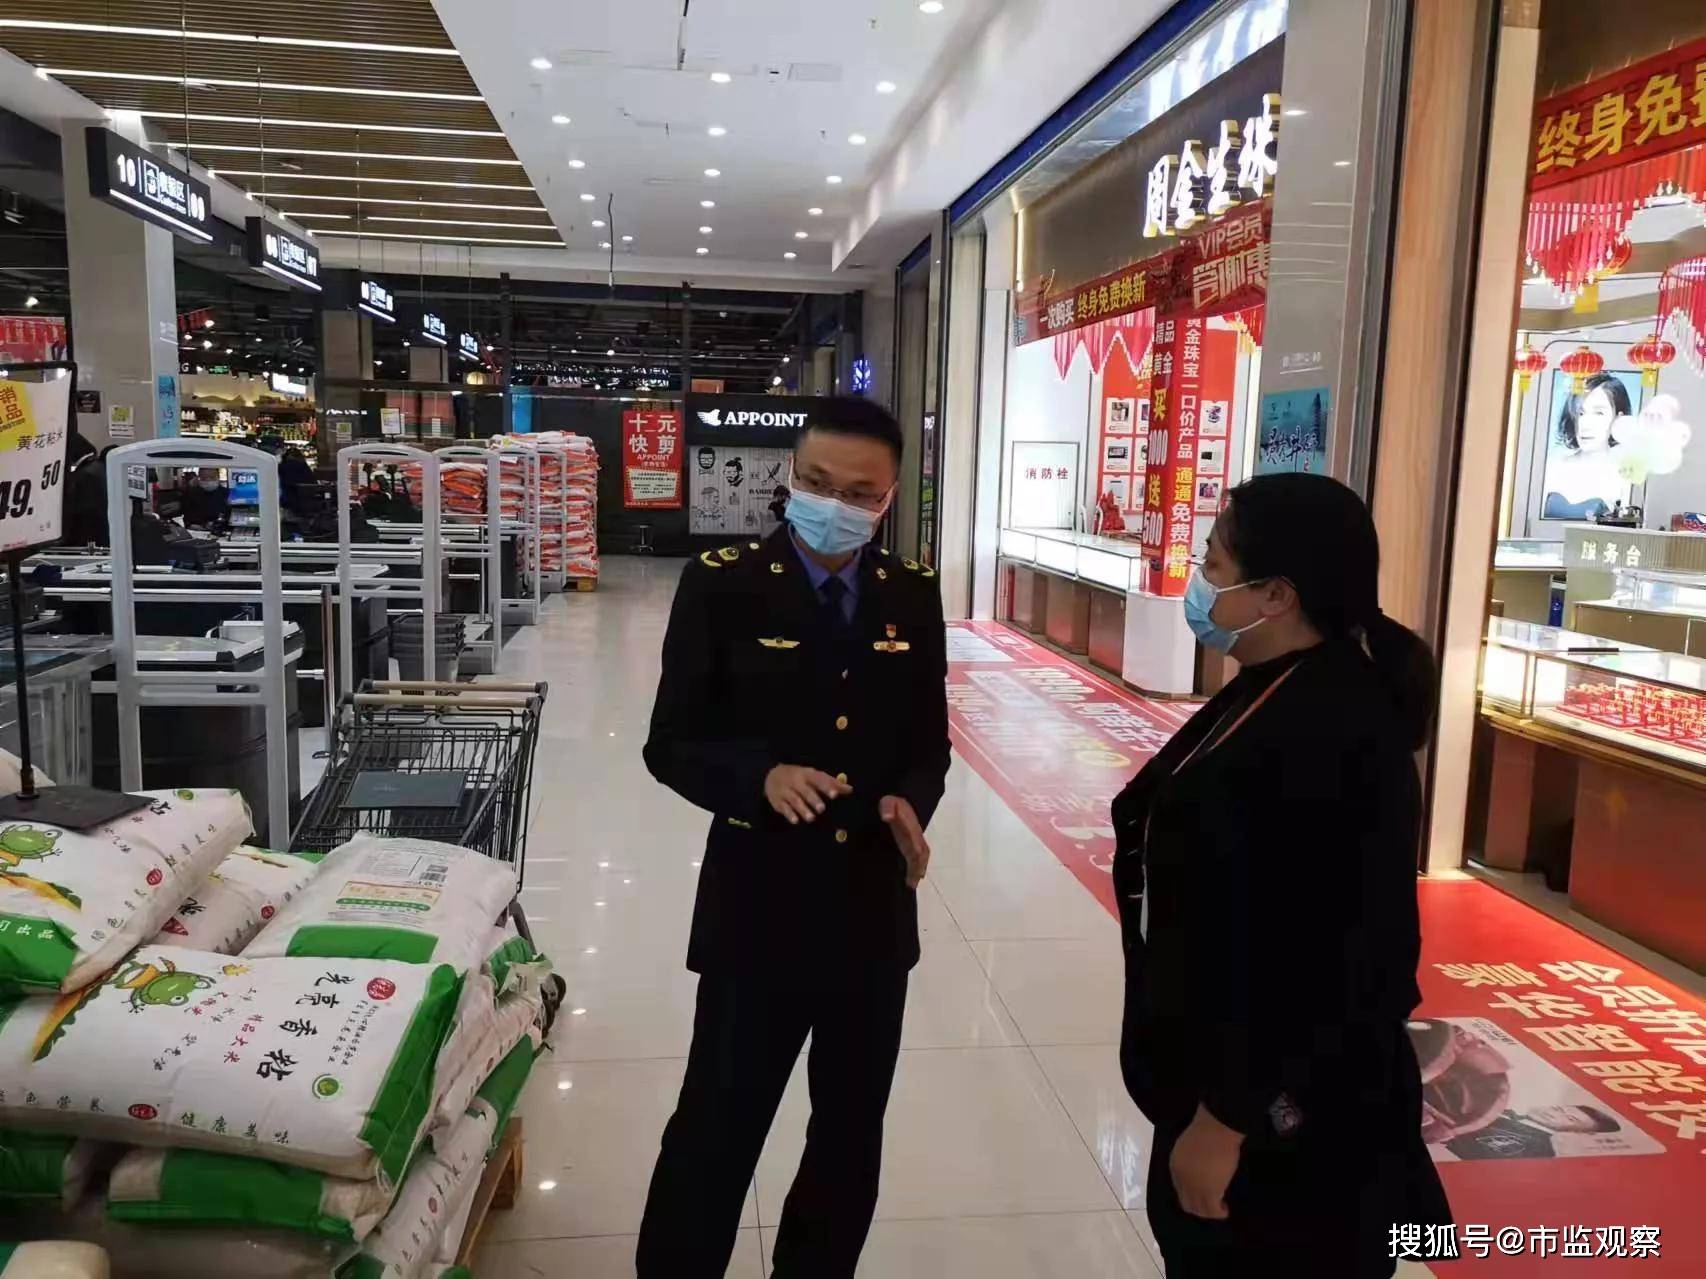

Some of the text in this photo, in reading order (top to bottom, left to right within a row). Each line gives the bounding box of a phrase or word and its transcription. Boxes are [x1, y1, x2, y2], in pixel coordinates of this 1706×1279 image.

[117, 153, 136, 187] 10
[1039, 271, 1146, 329] 一次购买 终身免费换新
[724, 411, 808, 428] APPOINT
[628, 434, 676, 455] 快剪
[1148, 428, 1169, 466] 1000
[41, 459, 61, 490] 50
[1025, 467, 1069, 480] 消防栓
[1142, 511, 1164, 546] 500
[1581, 540, 1642, 566] 服务台
